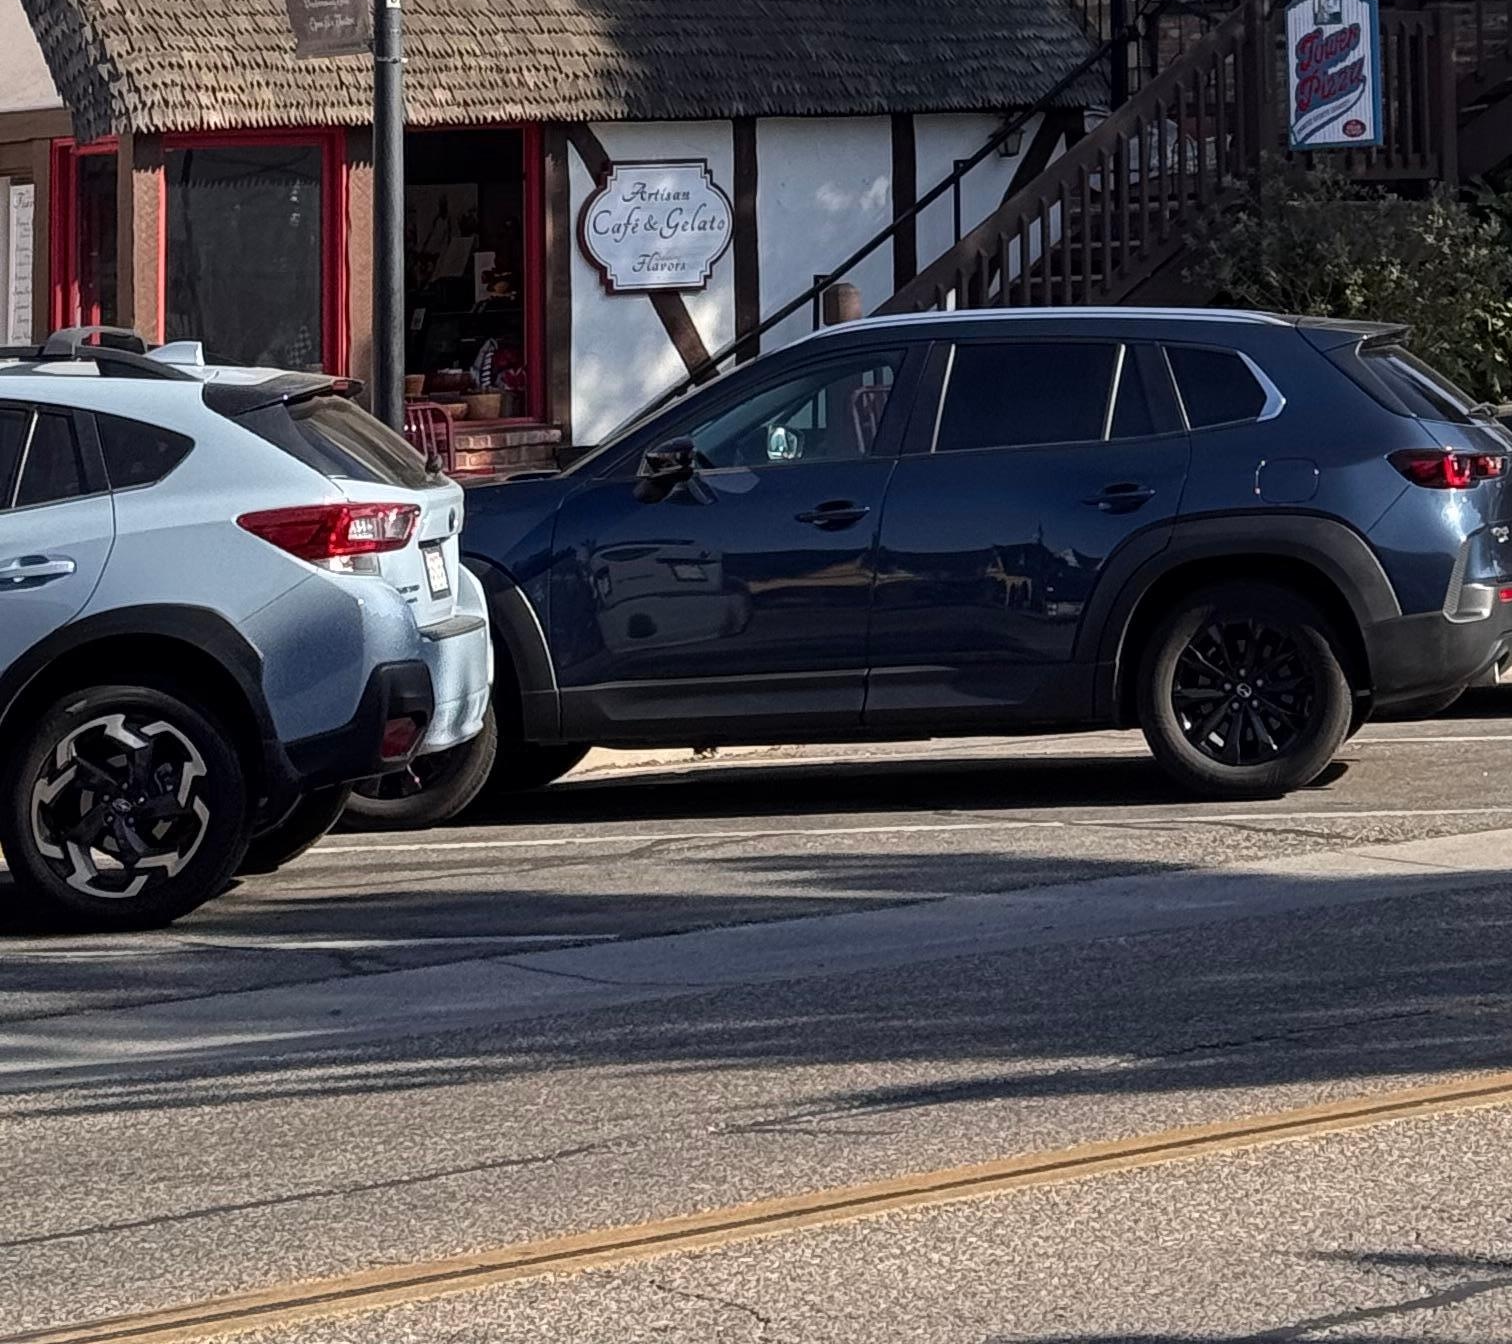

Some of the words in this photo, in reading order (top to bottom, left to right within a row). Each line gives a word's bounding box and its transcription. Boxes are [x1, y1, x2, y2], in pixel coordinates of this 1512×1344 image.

[1296, 24, 1361, 72] Tower
[1296, 55, 1366, 113] Pizza
[621, 181, 691, 203] Artisan
[592, 206, 641, 243] Café
[643, 214, 659, 231] &
[659, 203, 726, 240] Gelato
[631, 251, 687, 273] Flavors
